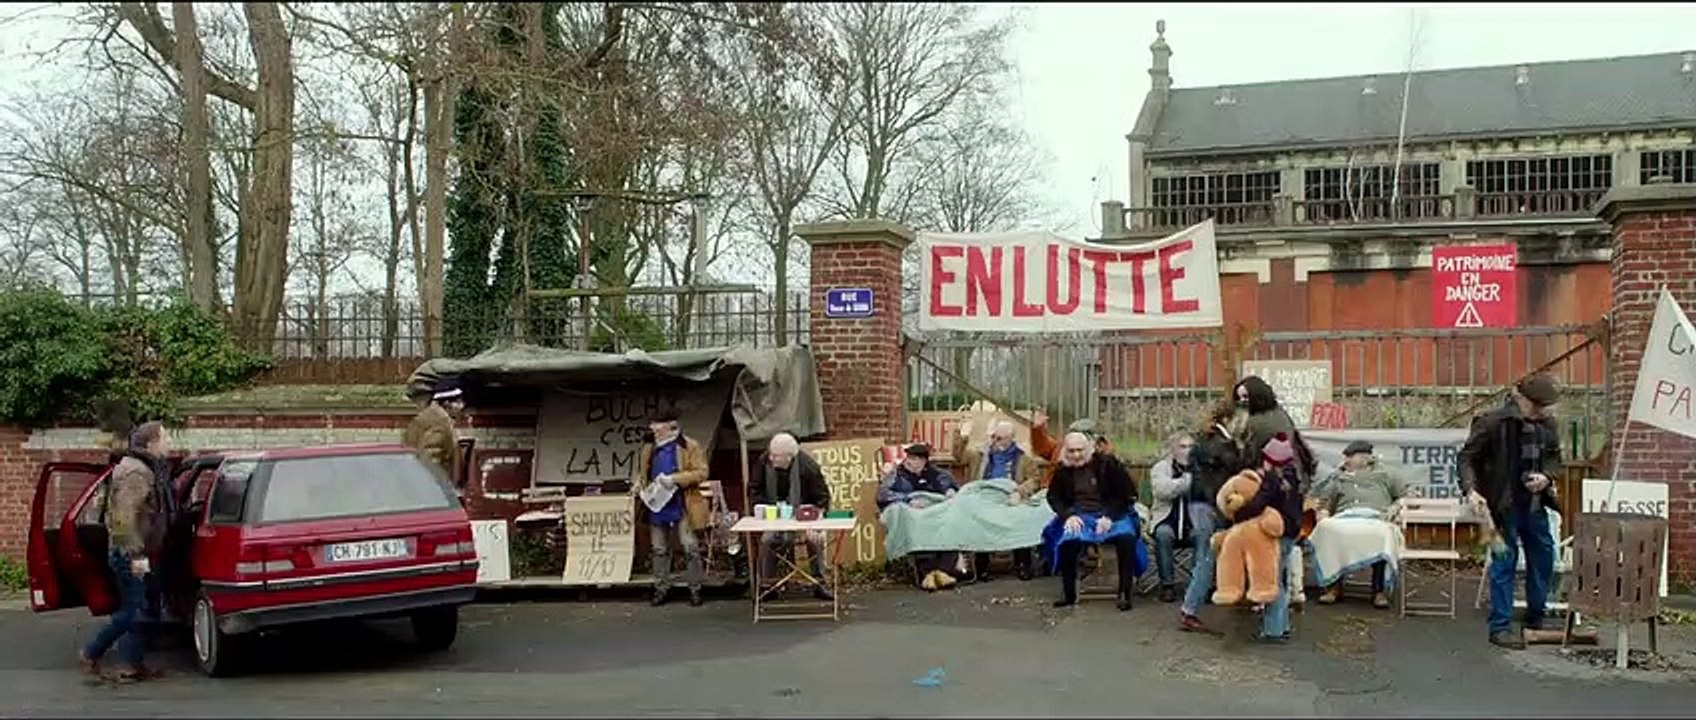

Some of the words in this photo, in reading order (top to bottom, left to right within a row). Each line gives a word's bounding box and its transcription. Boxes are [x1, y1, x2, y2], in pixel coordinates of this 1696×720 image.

[1461, 272, 1480, 286] EN
[1445, 283, 1501, 302] DANGER
[566, 449, 602, 475] LA
[813, 445, 862, 464] TOUS
[1400, 446, 1458, 465] TERR
[828, 484, 861, 503] VEC
